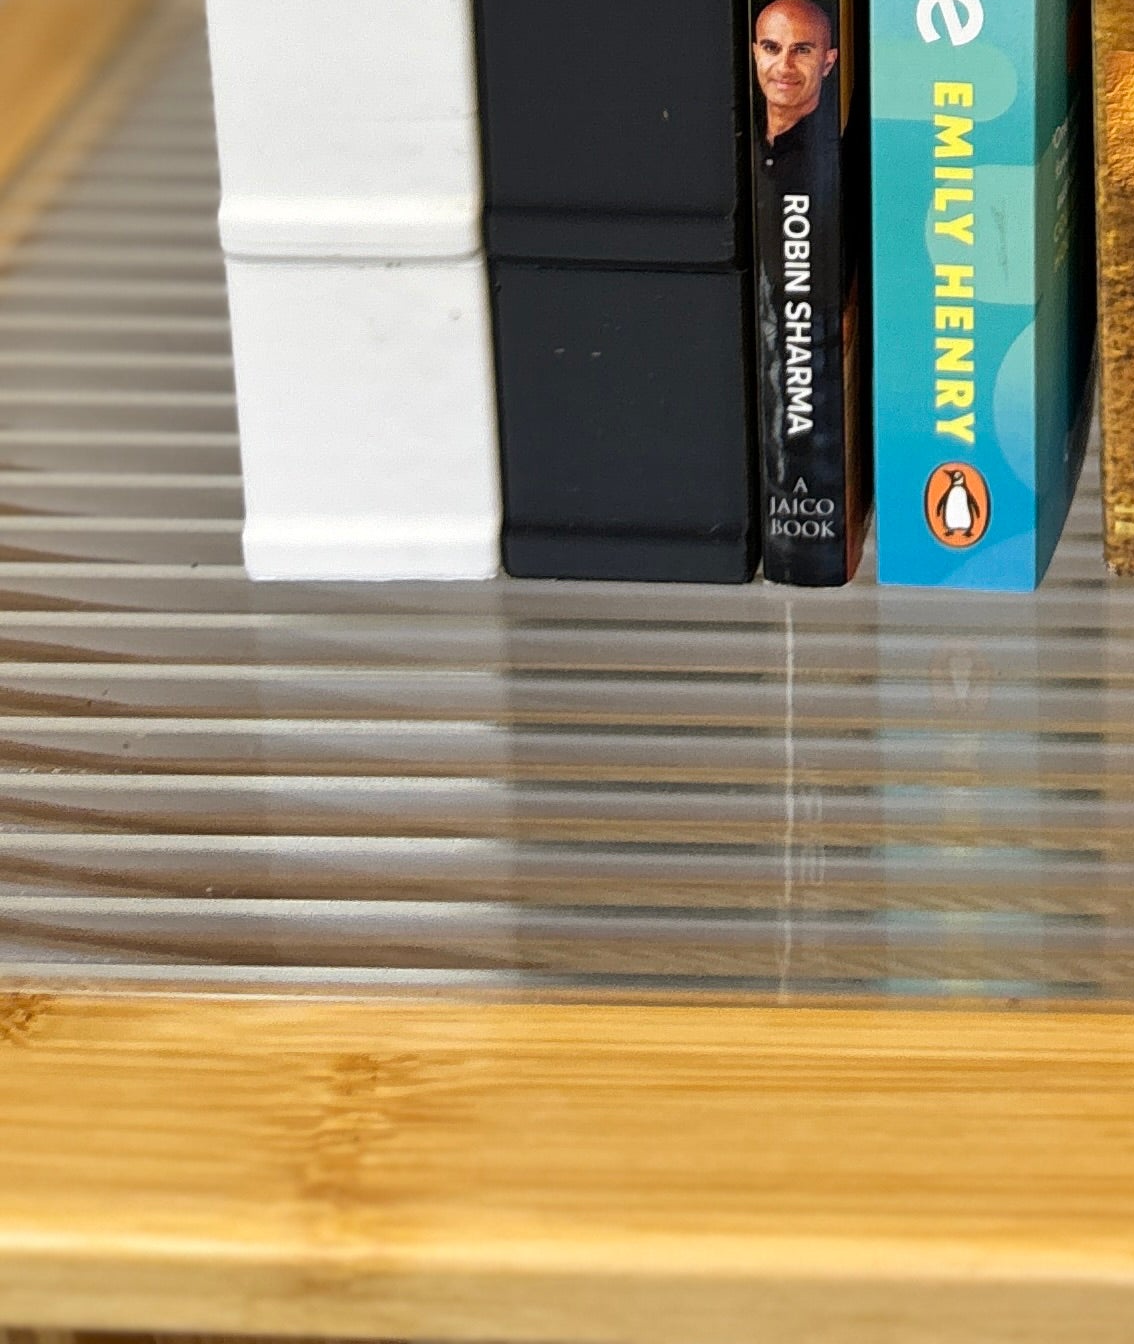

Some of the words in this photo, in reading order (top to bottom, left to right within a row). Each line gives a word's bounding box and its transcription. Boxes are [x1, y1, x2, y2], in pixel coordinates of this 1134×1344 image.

[933, 81, 975, 246] EMILY
[782, 194, 811, 292] ROBIN
[783, 301, 814, 435] SHARMA
[934, 263, 976, 444] HENRY
[769, 496, 835, 516] JAICO
[769, 518, 836, 538] BOOK
[792, 476, 808, 493] A
